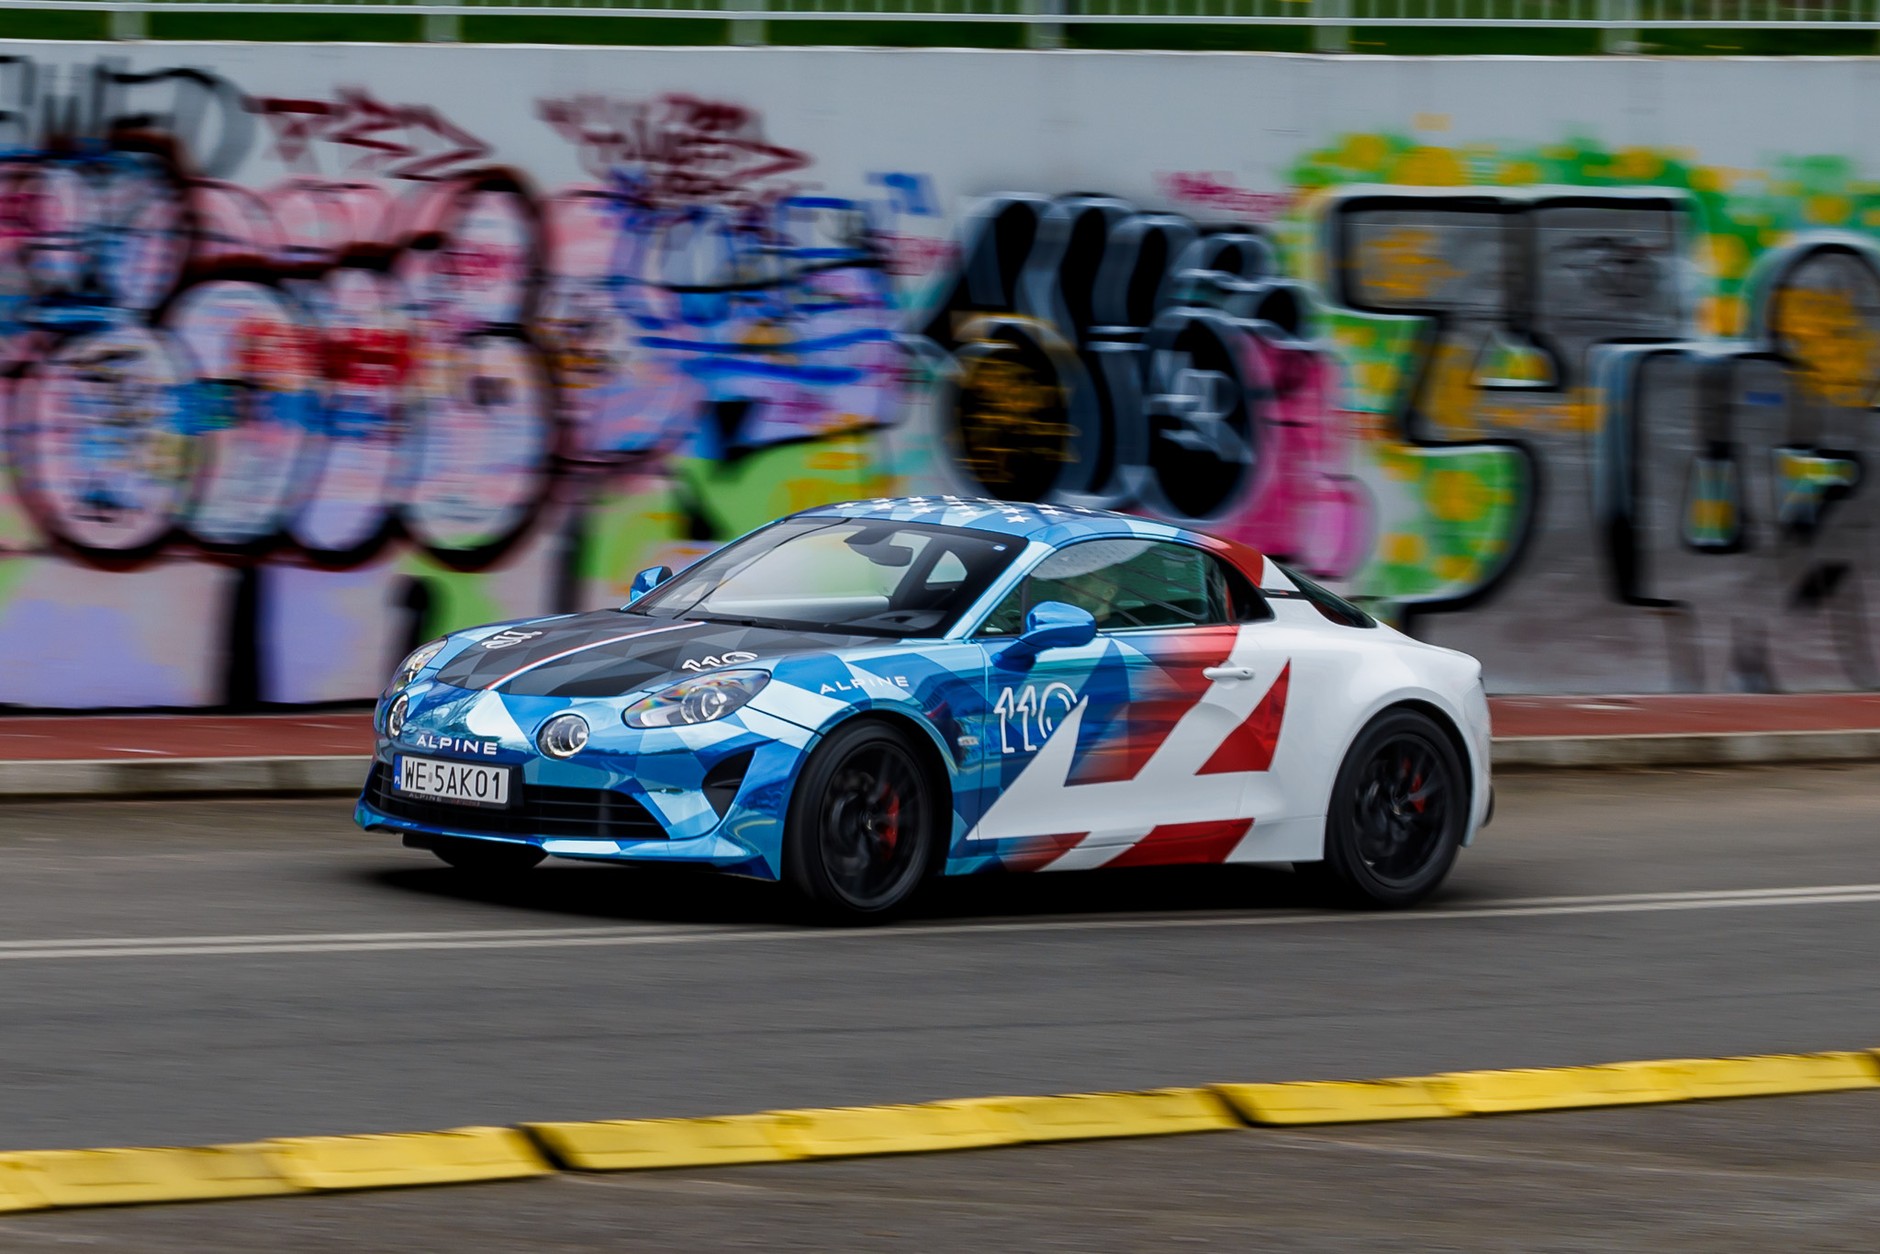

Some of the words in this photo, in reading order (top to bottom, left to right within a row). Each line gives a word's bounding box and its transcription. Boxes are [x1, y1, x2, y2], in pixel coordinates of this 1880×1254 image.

[820, 676, 909, 695] ALPINE
[993, 682, 1078, 754] 110
[416, 734, 498, 755] ALPINE
[404, 760, 427, 791] WE
[433, 765, 500, 800] 5AK01
